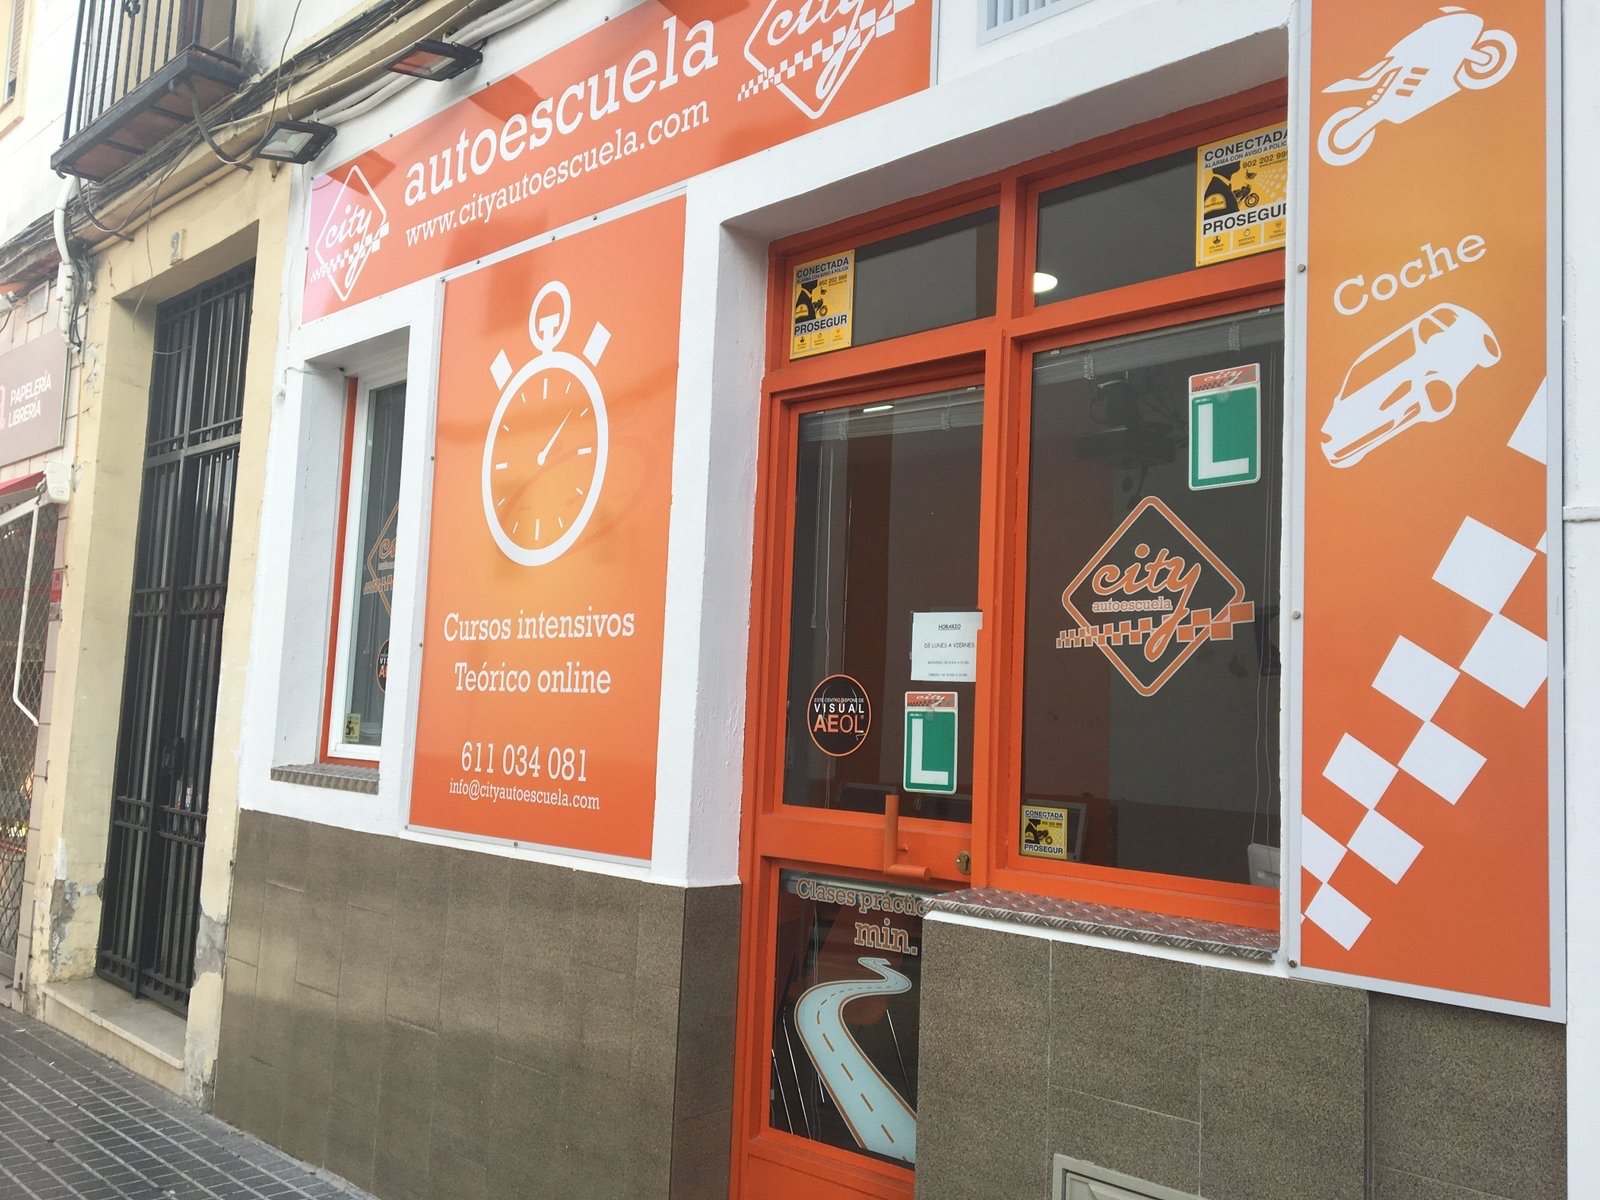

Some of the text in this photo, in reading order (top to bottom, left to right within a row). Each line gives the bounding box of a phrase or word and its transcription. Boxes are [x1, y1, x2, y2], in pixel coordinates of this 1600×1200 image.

[403, 15, 719, 207] autoescuela
[1230, 152, 1244, 163] CON
[1244, 147, 1263, 159] AVISO
[1269, 139, 1288, 151] POLIC
[1242, 159, 1257, 169] 902
[1260, 154, 1274, 165] 202
[405, 100, 710, 248] www.cityautoescuela.com
[325, 203, 373, 290] city
[797, 258, 849, 279] CONECTADA
[1333, 234, 1487, 316] Coche
[794, 315, 848, 336] PROSEGUR
[10, 369, 52, 407] PAPELERÍA
[7, 397, 42, 428] LIBRERÍA
[1197, 403, 1250, 480] L
[1091, 543, 1202, 662] city
[1091, 596, 1173, 613] autoescuela
[443, 606, 636, 642] Cursos intensivos
[454, 661, 612, 694] Teórico online
[813, 703, 865, 713] VISUAL
[461, 741, 588, 782] 611 034 081
[910, 718, 949, 785] L
[449, 778, 601, 810] info@cityautoescuela.com
[1024, 809, 1064, 818] CONECTADA
[1024, 843, 1064, 855] PROSEGUR
[796, 877, 929, 918] Clases práctic
[853, 917, 919, 956] min.
